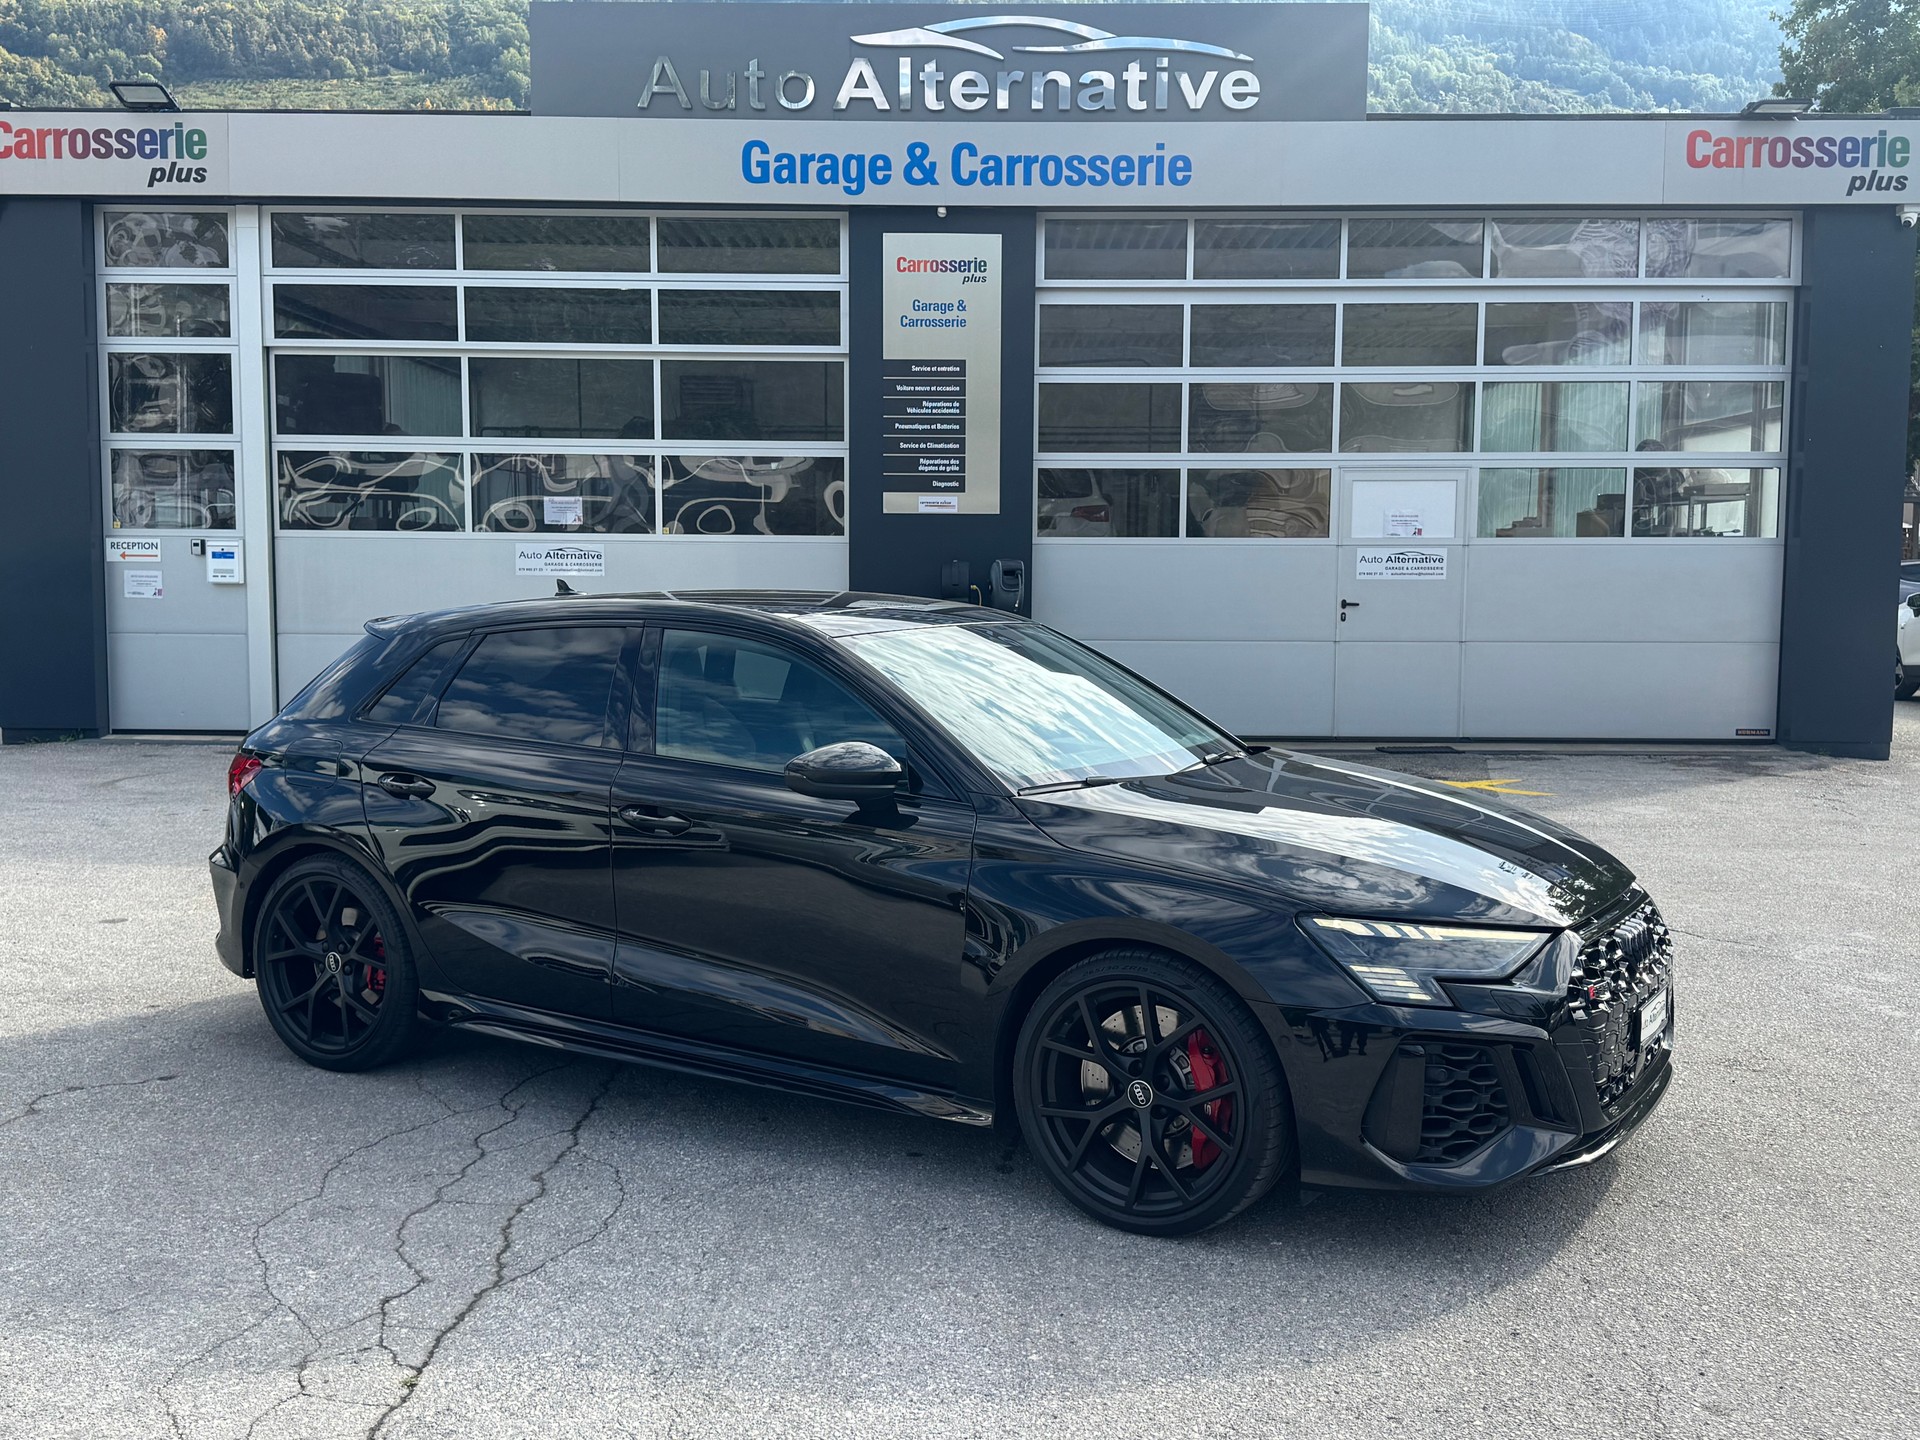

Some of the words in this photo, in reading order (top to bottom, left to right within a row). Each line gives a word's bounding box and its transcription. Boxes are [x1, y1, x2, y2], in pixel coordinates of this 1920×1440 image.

[637, 55, 815, 110] Auto
[833, 55, 1261, 111] Alternative
[1686, 129, 1911, 169] Carrosserie
[741, 139, 892, 195] Garage
[903, 142, 939, 186] &
[951, 142, 1192, 187] Carrosserie
[147, 161, 207, 187] plus
[1846, 169, 1909, 196] plus
[896, 256, 987, 273] Carrosserie
[962, 273, 987, 285] plus
[912, 299, 954, 314] Garage
[957, 299, 967, 312] &
[900, 314, 967, 328] Carrosserie
[936, 384, 960, 392] occasion
[922, 400, 952, 408] Réparations
[932, 406, 960, 414] accidentés
[894, 423, 930, 431] Pneumatiques
[919, 458, 949, 466] Réparations
[932, 480, 959, 488] Diagnostic
[110, 541, 158, 550] RECEPTION
[518, 551, 542, 560] Auto
[544, 552, 602, 560] Alternative
[1360, 556, 1384, 564] Auto
[1386, 556, 1444, 564] Alternative
